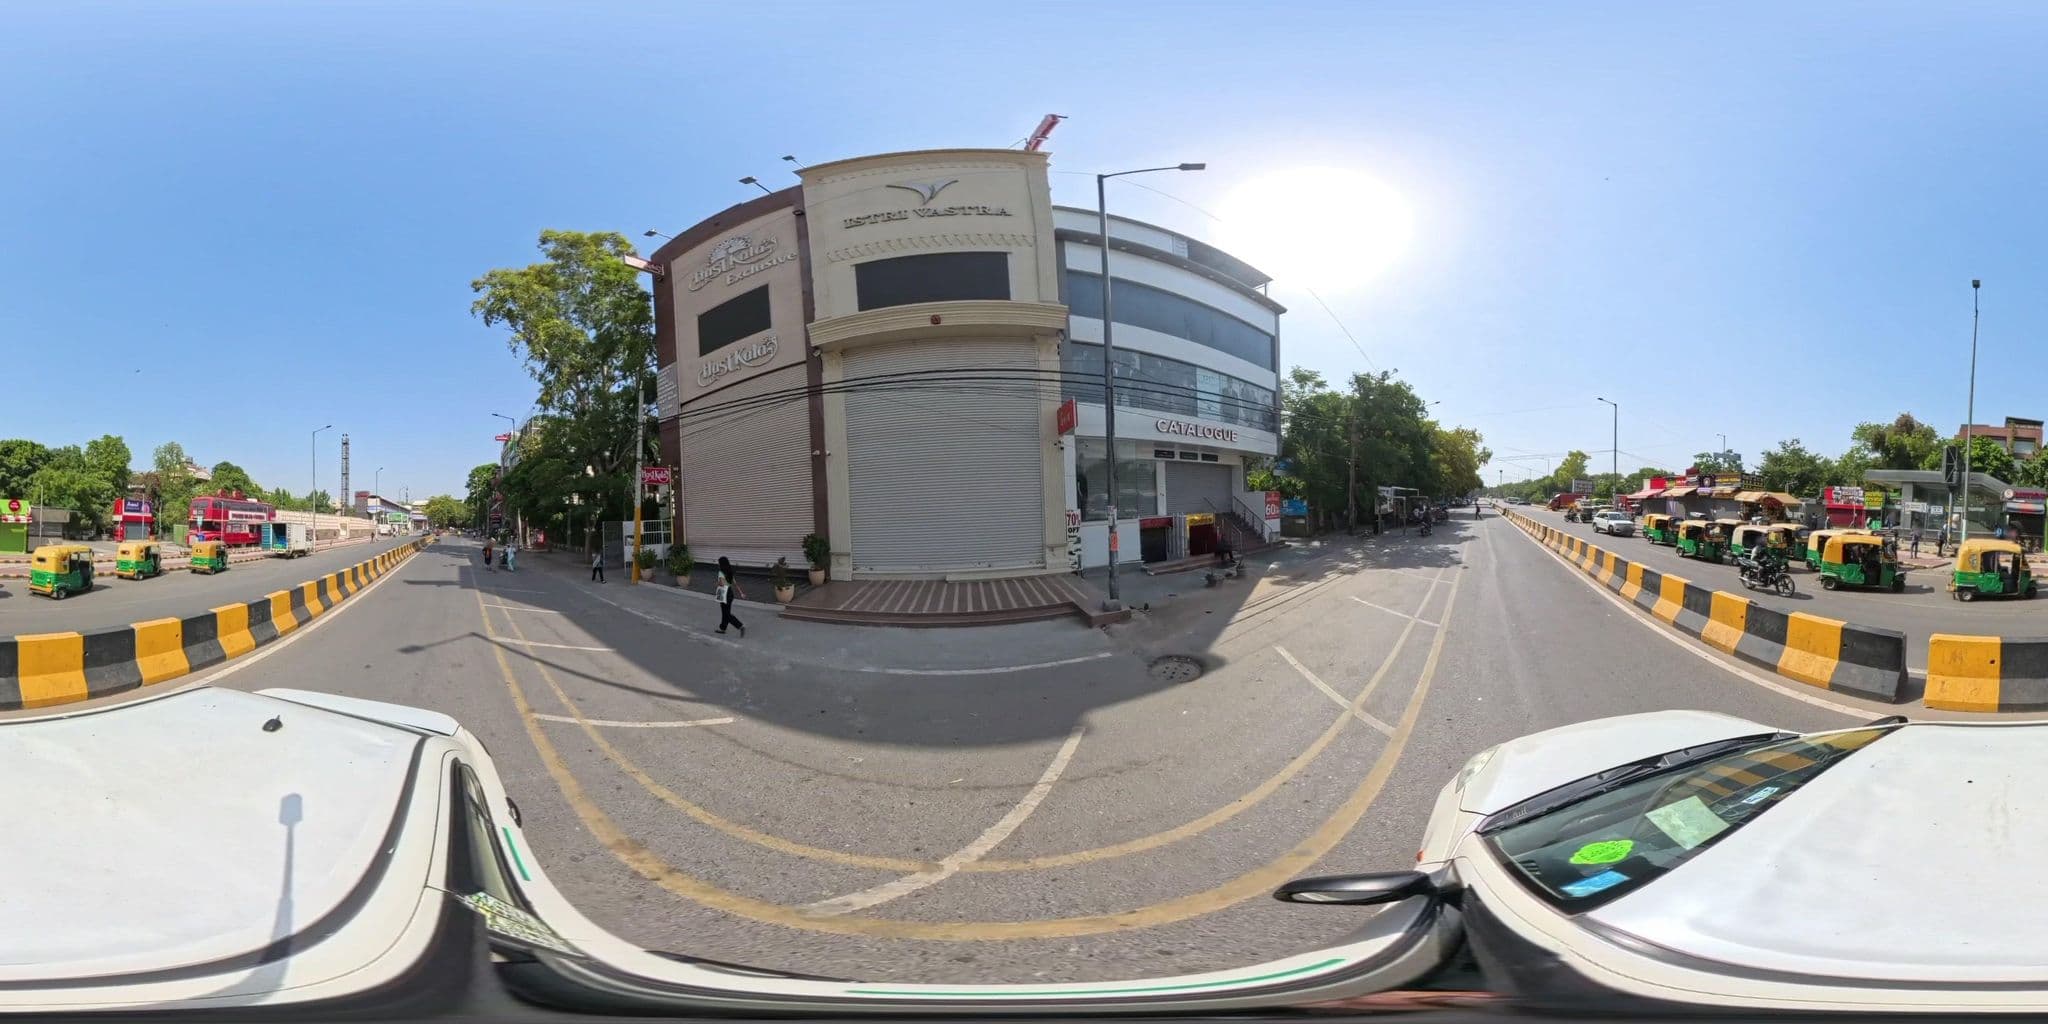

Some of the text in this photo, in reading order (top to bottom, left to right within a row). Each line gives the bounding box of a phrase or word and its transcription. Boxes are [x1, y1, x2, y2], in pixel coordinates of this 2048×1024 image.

[843, 206, 1013, 229] ISTRI VASTRA
[727, 251, 798, 287] Exclusive
[1156, 418, 1239, 443] CATALOGUE
